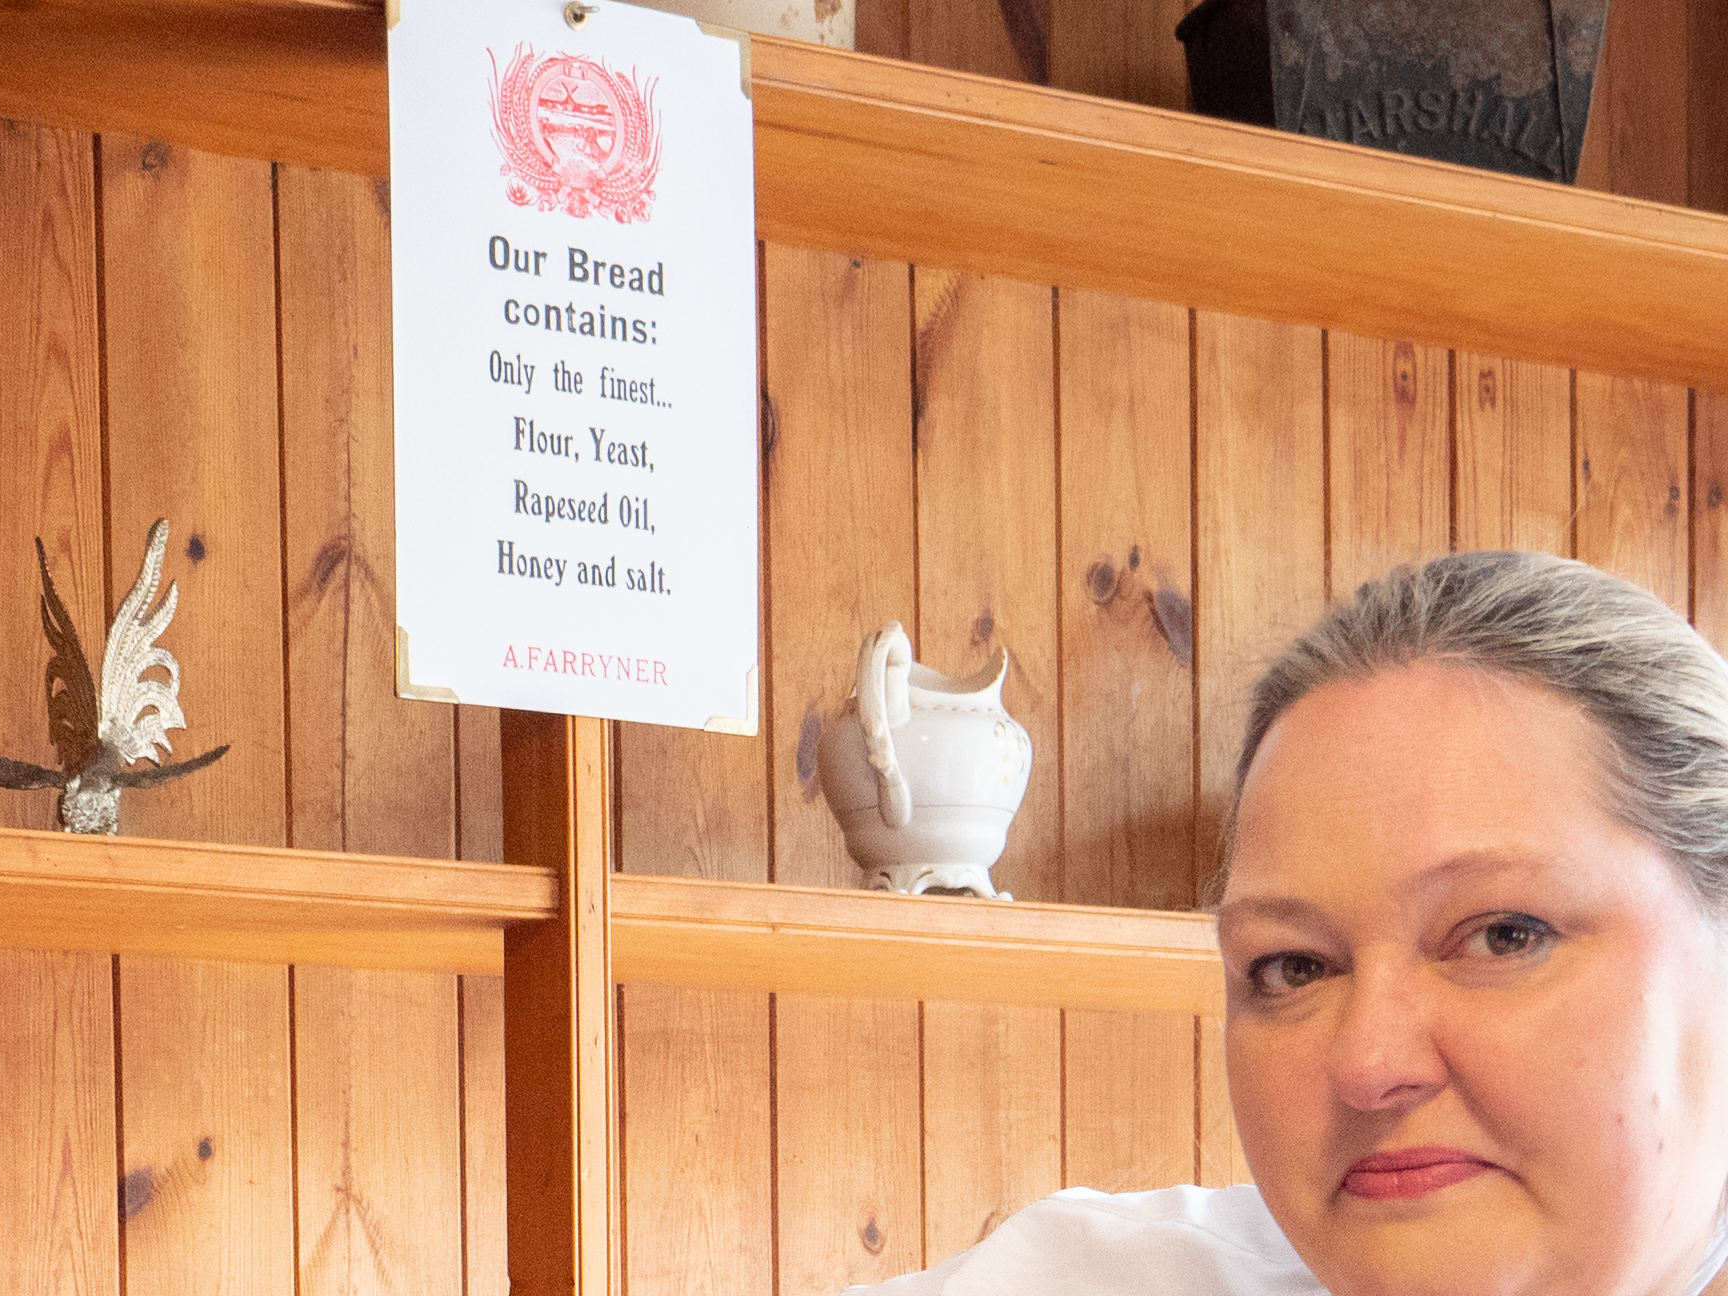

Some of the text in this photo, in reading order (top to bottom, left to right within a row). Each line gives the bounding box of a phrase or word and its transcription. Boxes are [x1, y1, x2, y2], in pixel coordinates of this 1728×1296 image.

[489, 235, 665, 297] Our Bread
[504, 299, 657, 345] contains:
[489, 350, 672, 408] Only the finest...
[513, 416, 655, 473] Flour, Yeast,
[513, 479, 656, 535] Rapeseed Oil,
[497, 540, 671, 595] Honey and salt.
[502, 645, 668, 686] A.FARRYNER
